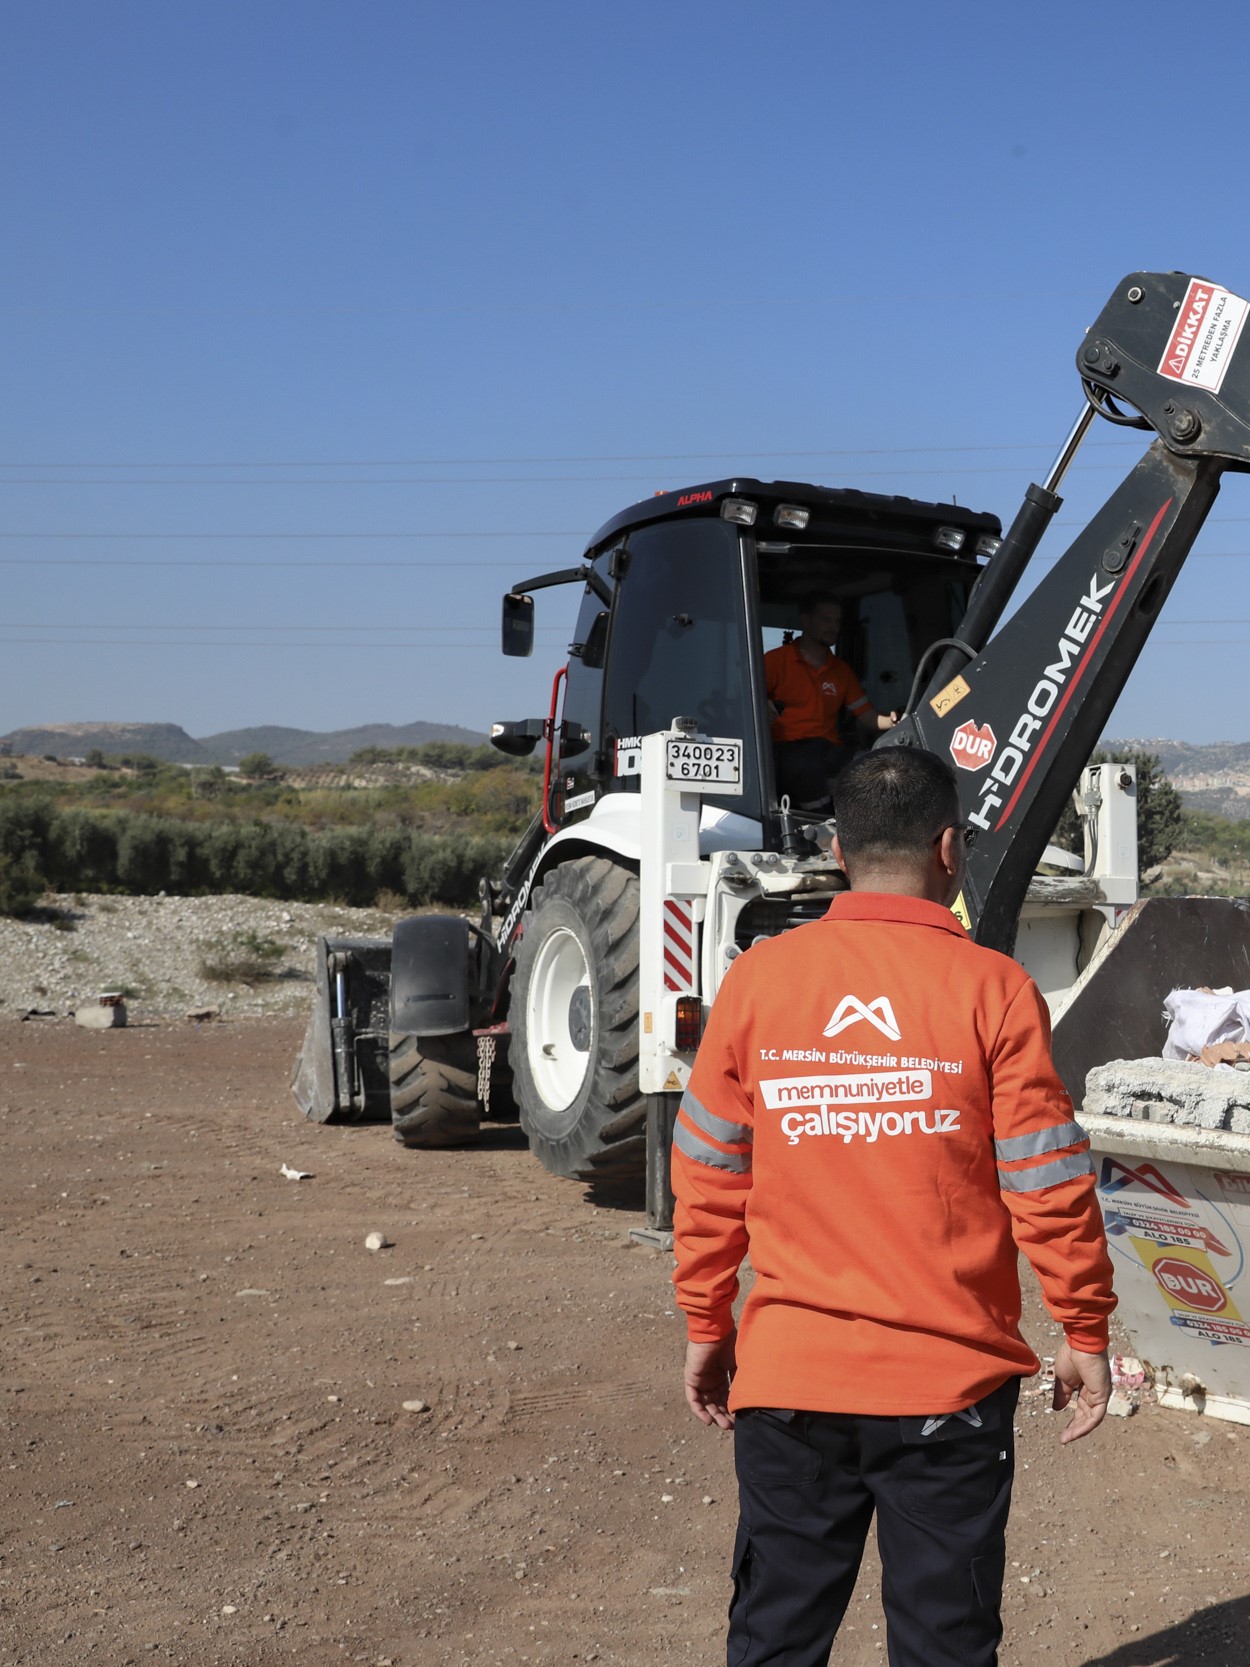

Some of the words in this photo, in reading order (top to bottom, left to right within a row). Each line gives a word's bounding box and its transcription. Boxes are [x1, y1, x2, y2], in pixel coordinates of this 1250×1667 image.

[1175, 288, 1209, 357] DİKKAT
[1191, 368, 1201, 379] 25
[1197, 323, 1217, 367] METREDEN
[1213, 296, 1227, 323] FAZLA
[1210, 320, 1231, 363] YAKLAŞMA
[677, 491, 713, 506] ALPHA
[617, 736, 642, 749] HMK
[671, 745, 735, 762] 340023
[954, 732, 991, 759] DUR
[681, 762, 720, 778] 6701
[760, 1049, 779, 1061] T.C.
[782, 1047, 826, 1062] MERSİN
[829, 1050, 898, 1069] BÜYÜKŞEHİR
[900, 1056, 963, 1074] BELEDİYESİ
[777, 1075, 924, 1102] memnuniyetle
[781, 1104, 961, 1145] çalışıyoruz
[1132, 1218, 1158, 1231] 0324
[1160, 1222, 1177, 1233] 185
[1177, 1225, 1192, 1236] 00
[1192, 1228, 1207, 1238] 00
[1144, 1230, 1168, 1241] ALO
[1170, 1235, 1191, 1246] 185
[1160, 1272, 1219, 1298] DUR
[1186, 1320, 1211, 1330] 0324
[1212, 1323, 1229, 1333] 185
[1230, 1326, 1242, 1336] 00
[1198, 1330, 1222, 1340] ALO
[1223, 1334, 1243, 1344] 185
